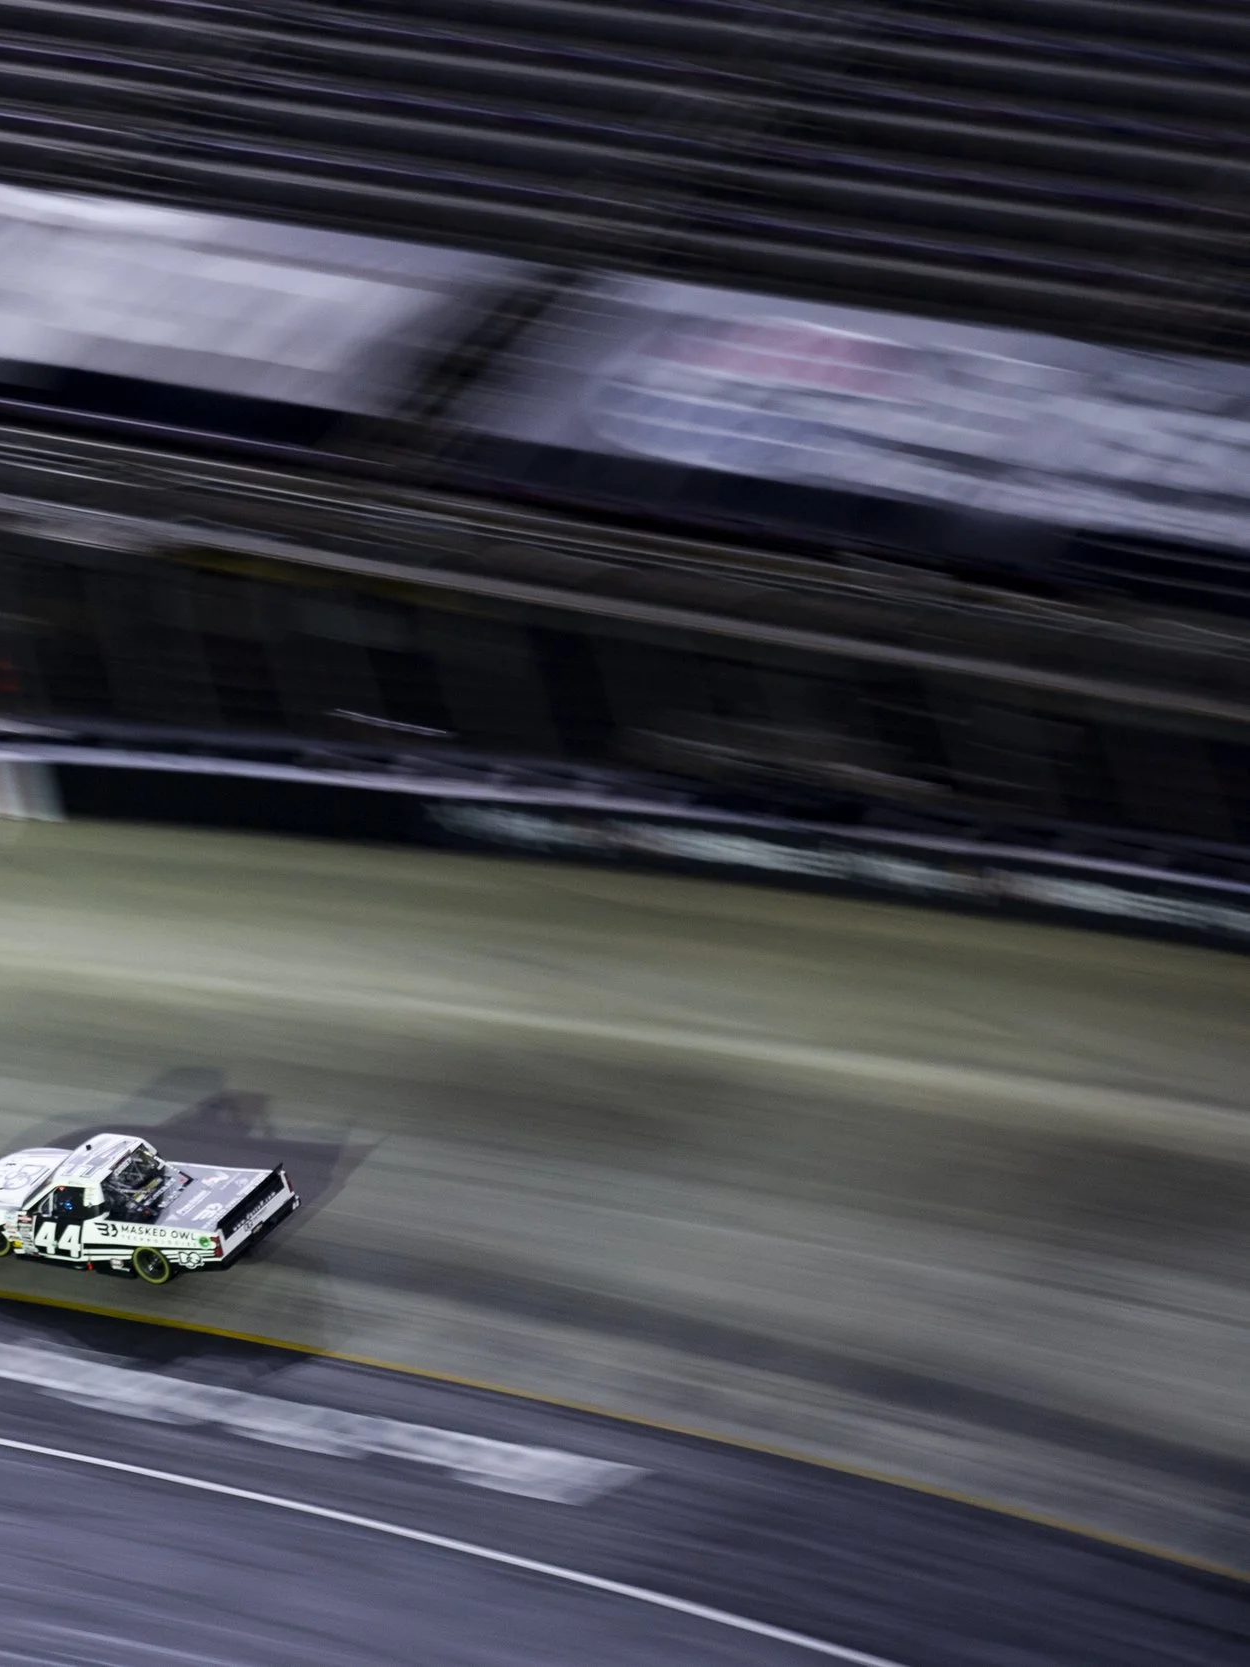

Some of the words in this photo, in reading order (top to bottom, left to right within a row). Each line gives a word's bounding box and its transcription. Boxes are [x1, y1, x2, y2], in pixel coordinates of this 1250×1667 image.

[35, 1221, 81, 1258] 44
[121, 1225, 166, 1237] MASKED
[171, 1230, 197, 1240] OWL
